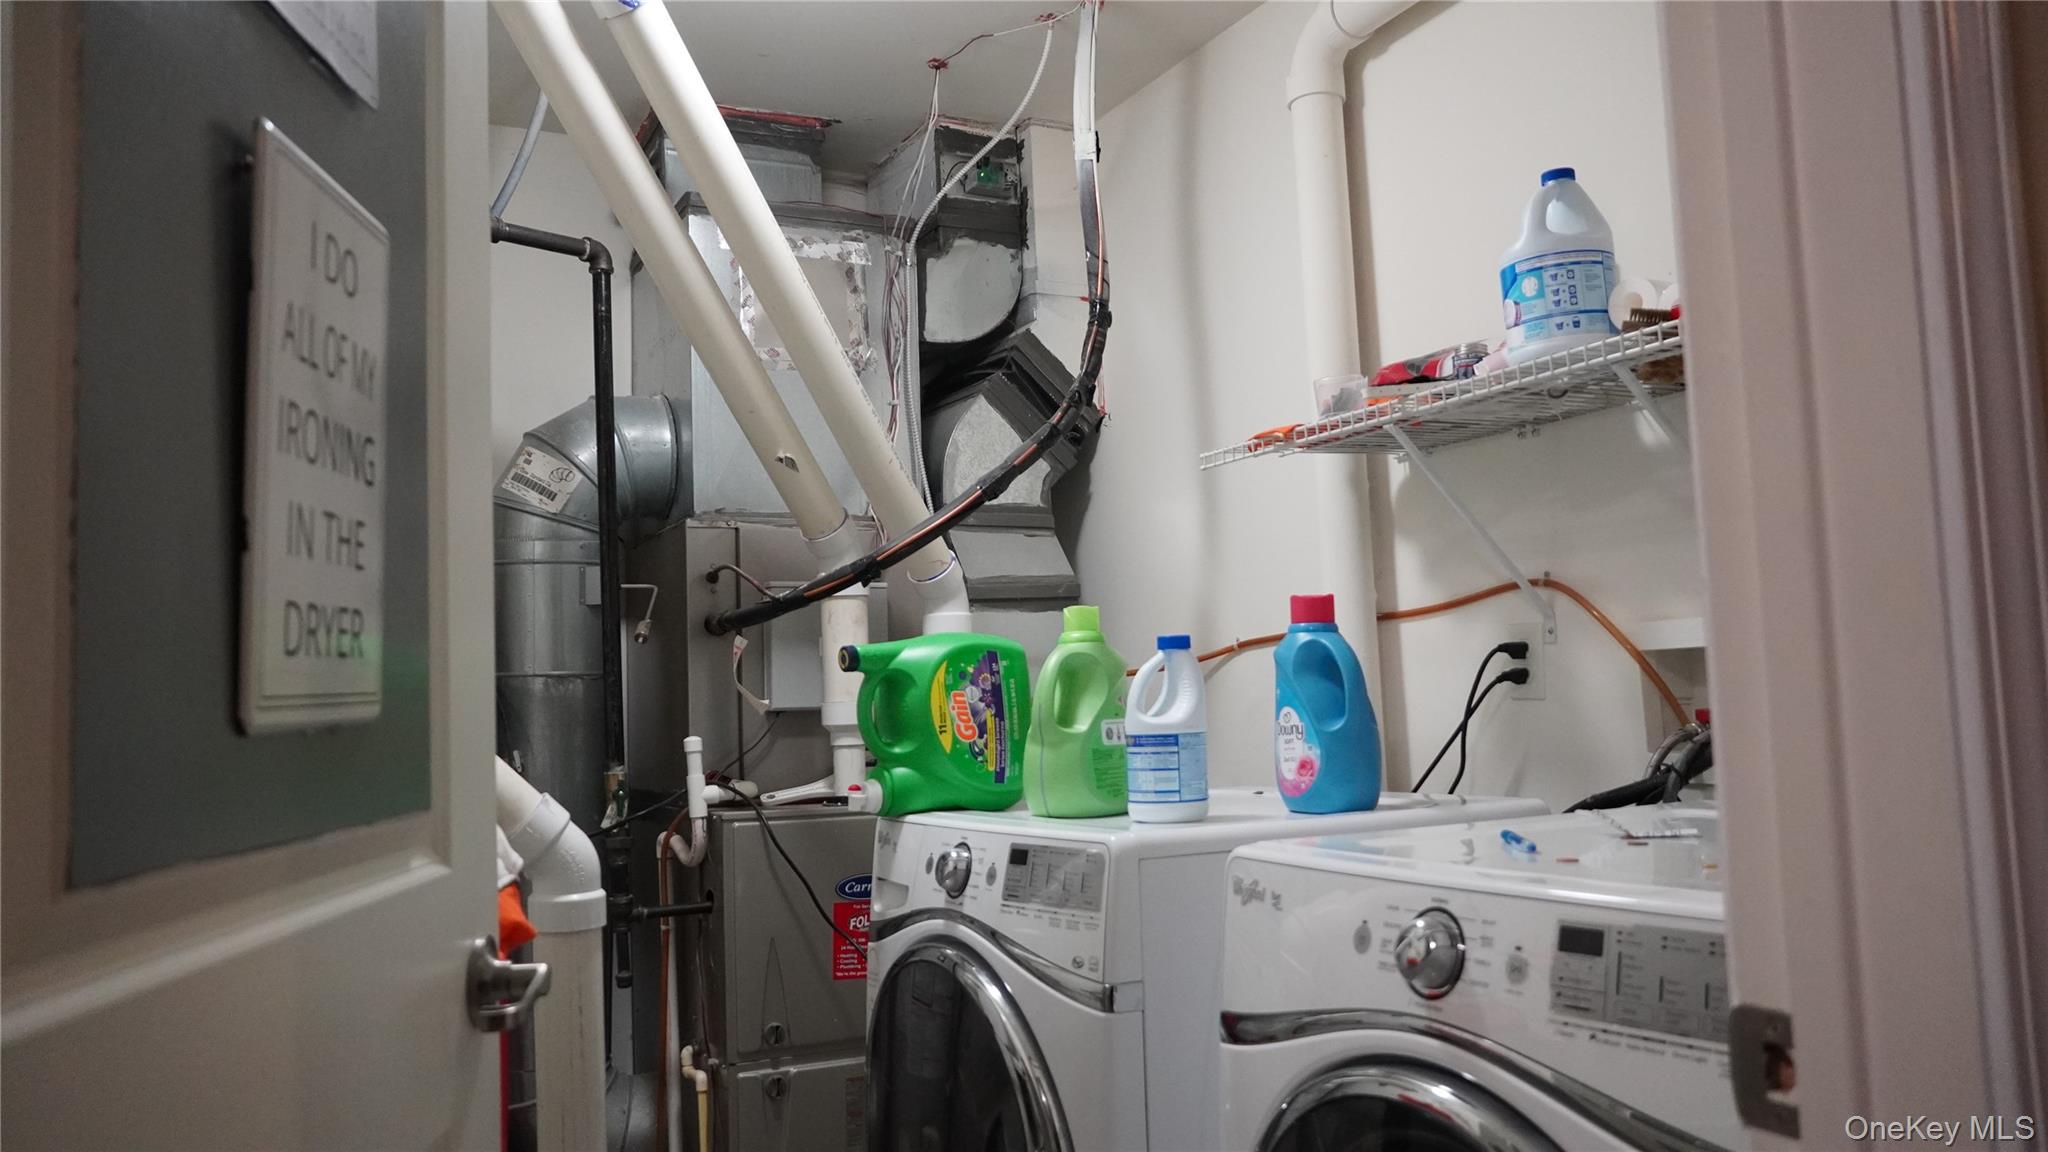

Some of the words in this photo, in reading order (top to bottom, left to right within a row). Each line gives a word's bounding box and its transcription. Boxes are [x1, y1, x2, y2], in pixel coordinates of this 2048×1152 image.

[309, 220, 317, 269] I
[324, 232, 359, 299] DO
[282, 302, 319, 371] ALL
[324, 325, 348, 384] OF
[351, 340, 377, 402] MY
[278, 395, 375, 487] IRONING
[287, 500, 315, 560] IN
[322, 510, 365, 571] THE
[284, 600, 365, 658] DRYER
[938, 724, 948, 736] 11
[950, 690, 978, 742] Gain
[845, 881, 872, 894] Carr
[849, 915, 870, 930] FOL
